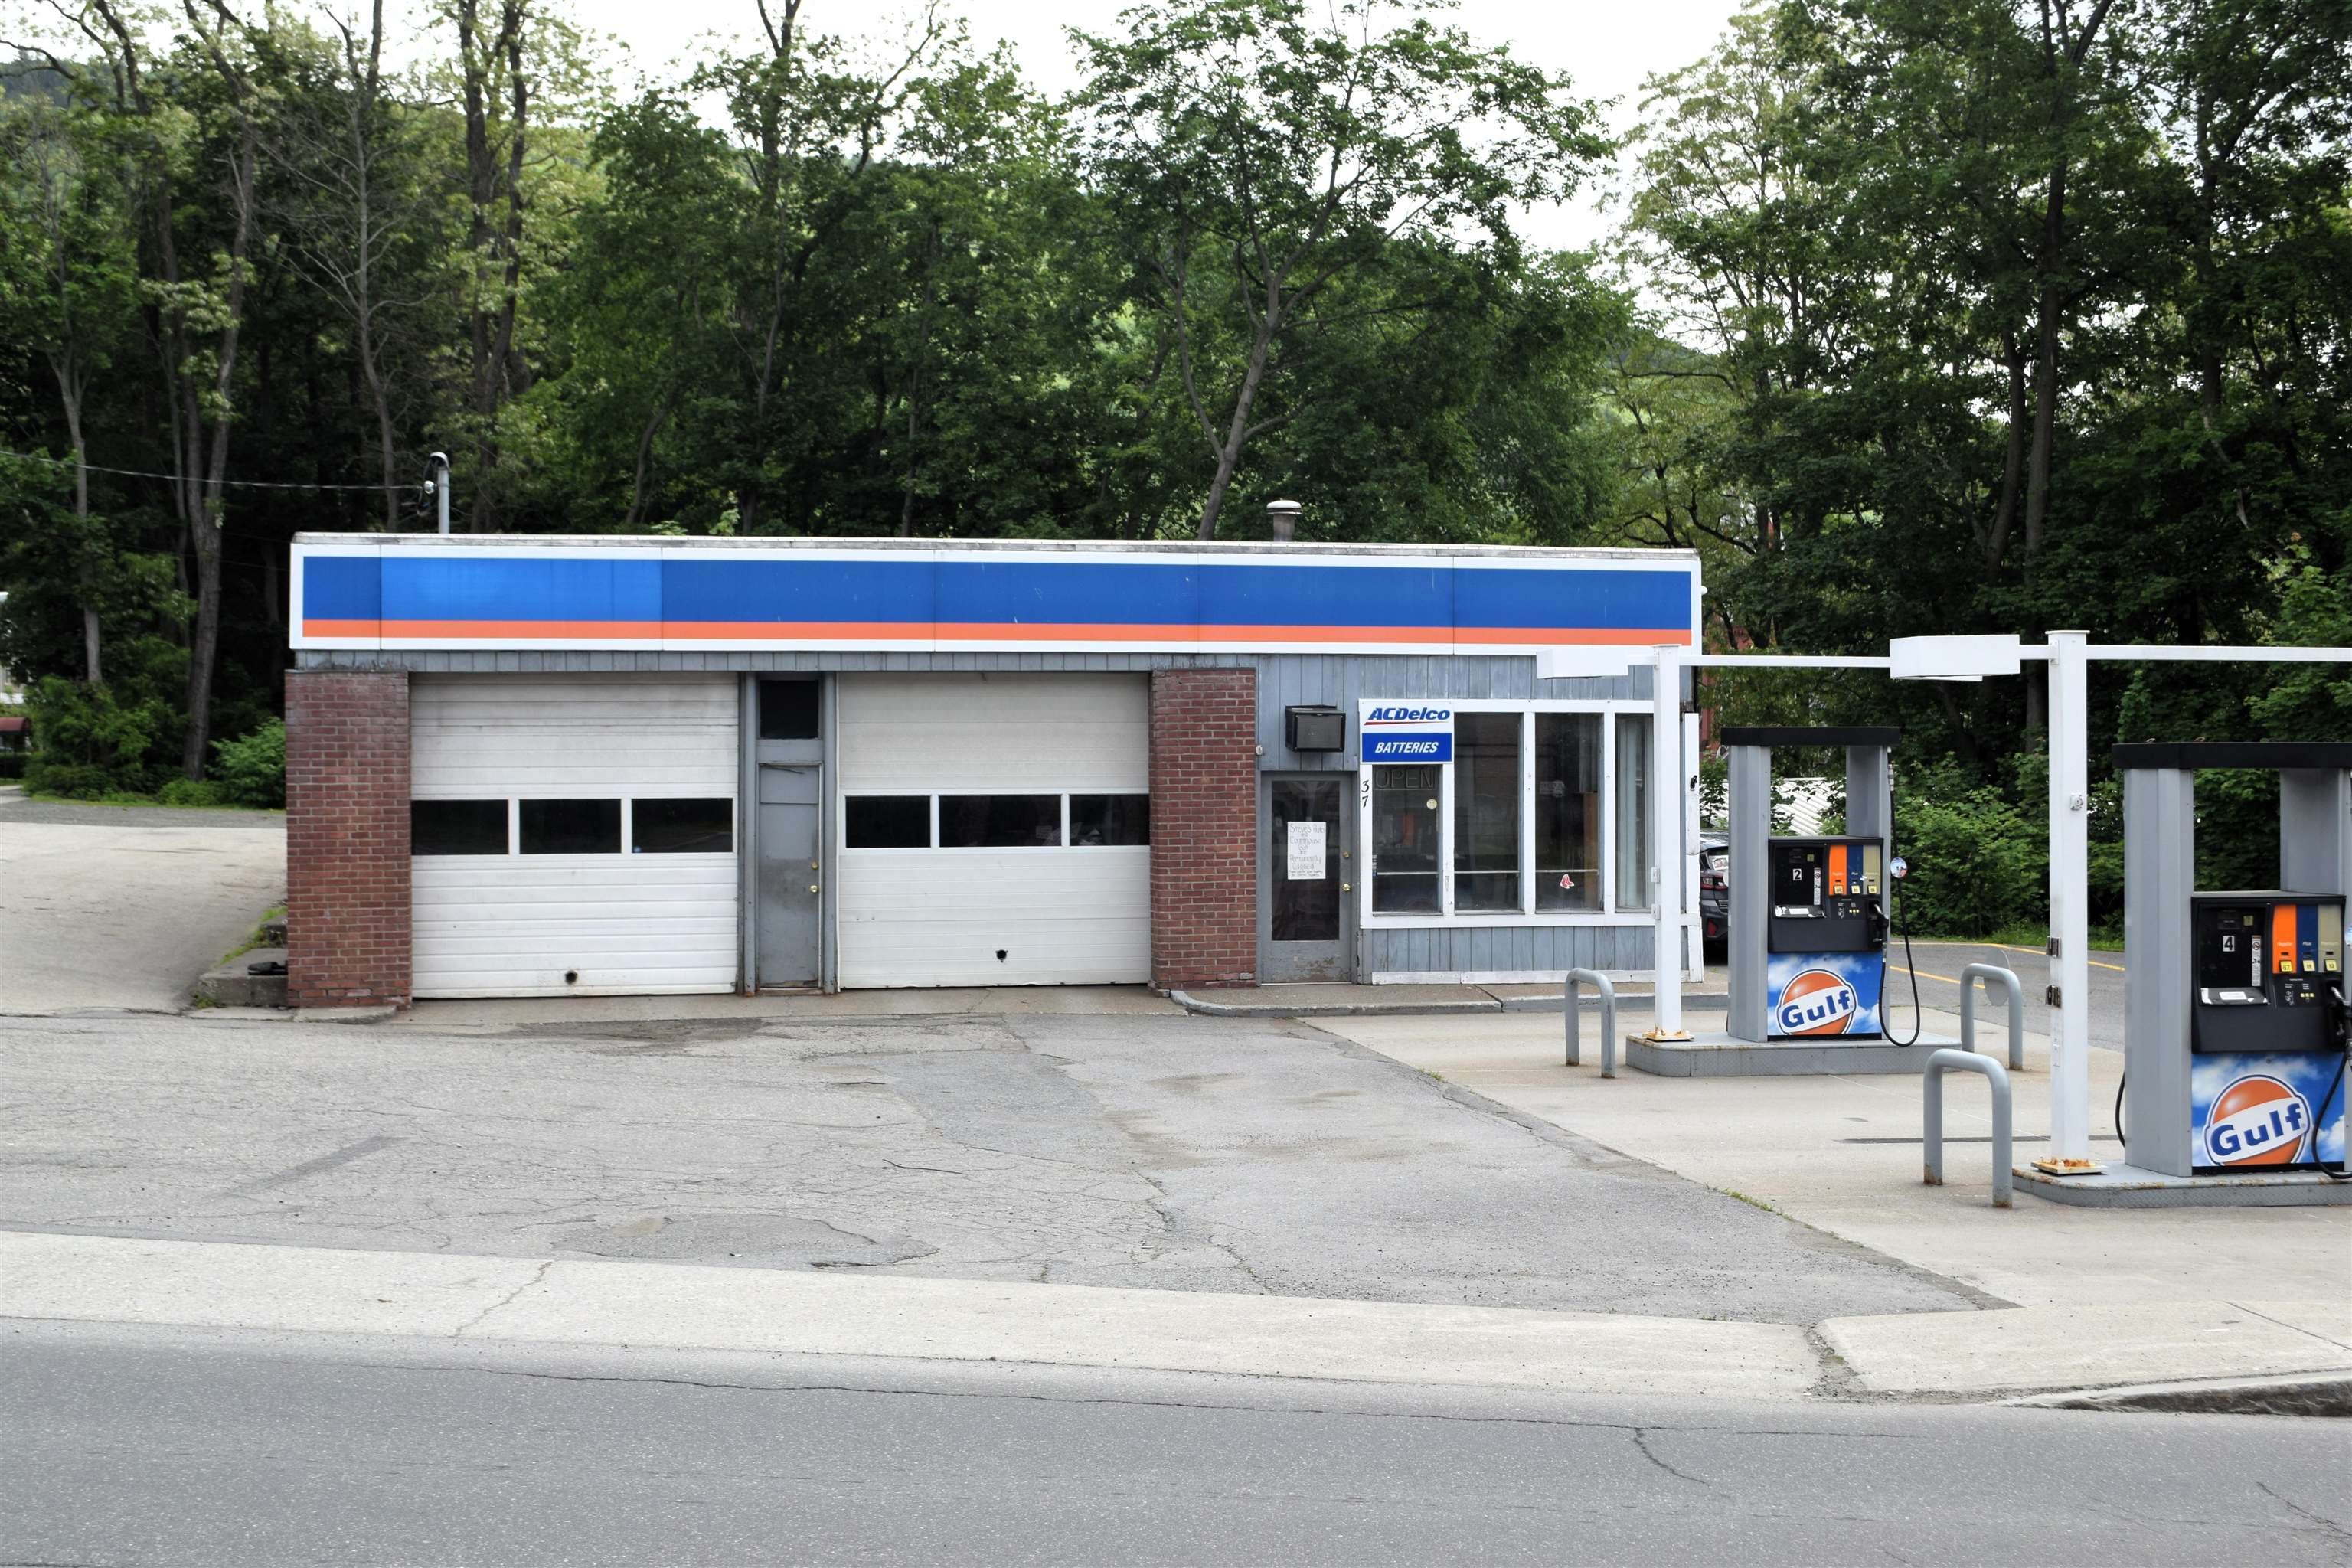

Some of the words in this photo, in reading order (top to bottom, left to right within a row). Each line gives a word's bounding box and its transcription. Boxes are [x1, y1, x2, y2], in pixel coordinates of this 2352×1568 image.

[1368, 707, 1450, 720] ACDelco
[1374, 741, 1439, 753] BATTERIES
[1375, 769, 1435, 789] OPEN
[1794, 869, 1801, 880] 2
[2224, 936, 2233, 951] 4
[1781, 989, 1851, 1028] Gulf
[2210, 1102, 2301, 1157] Gulf
